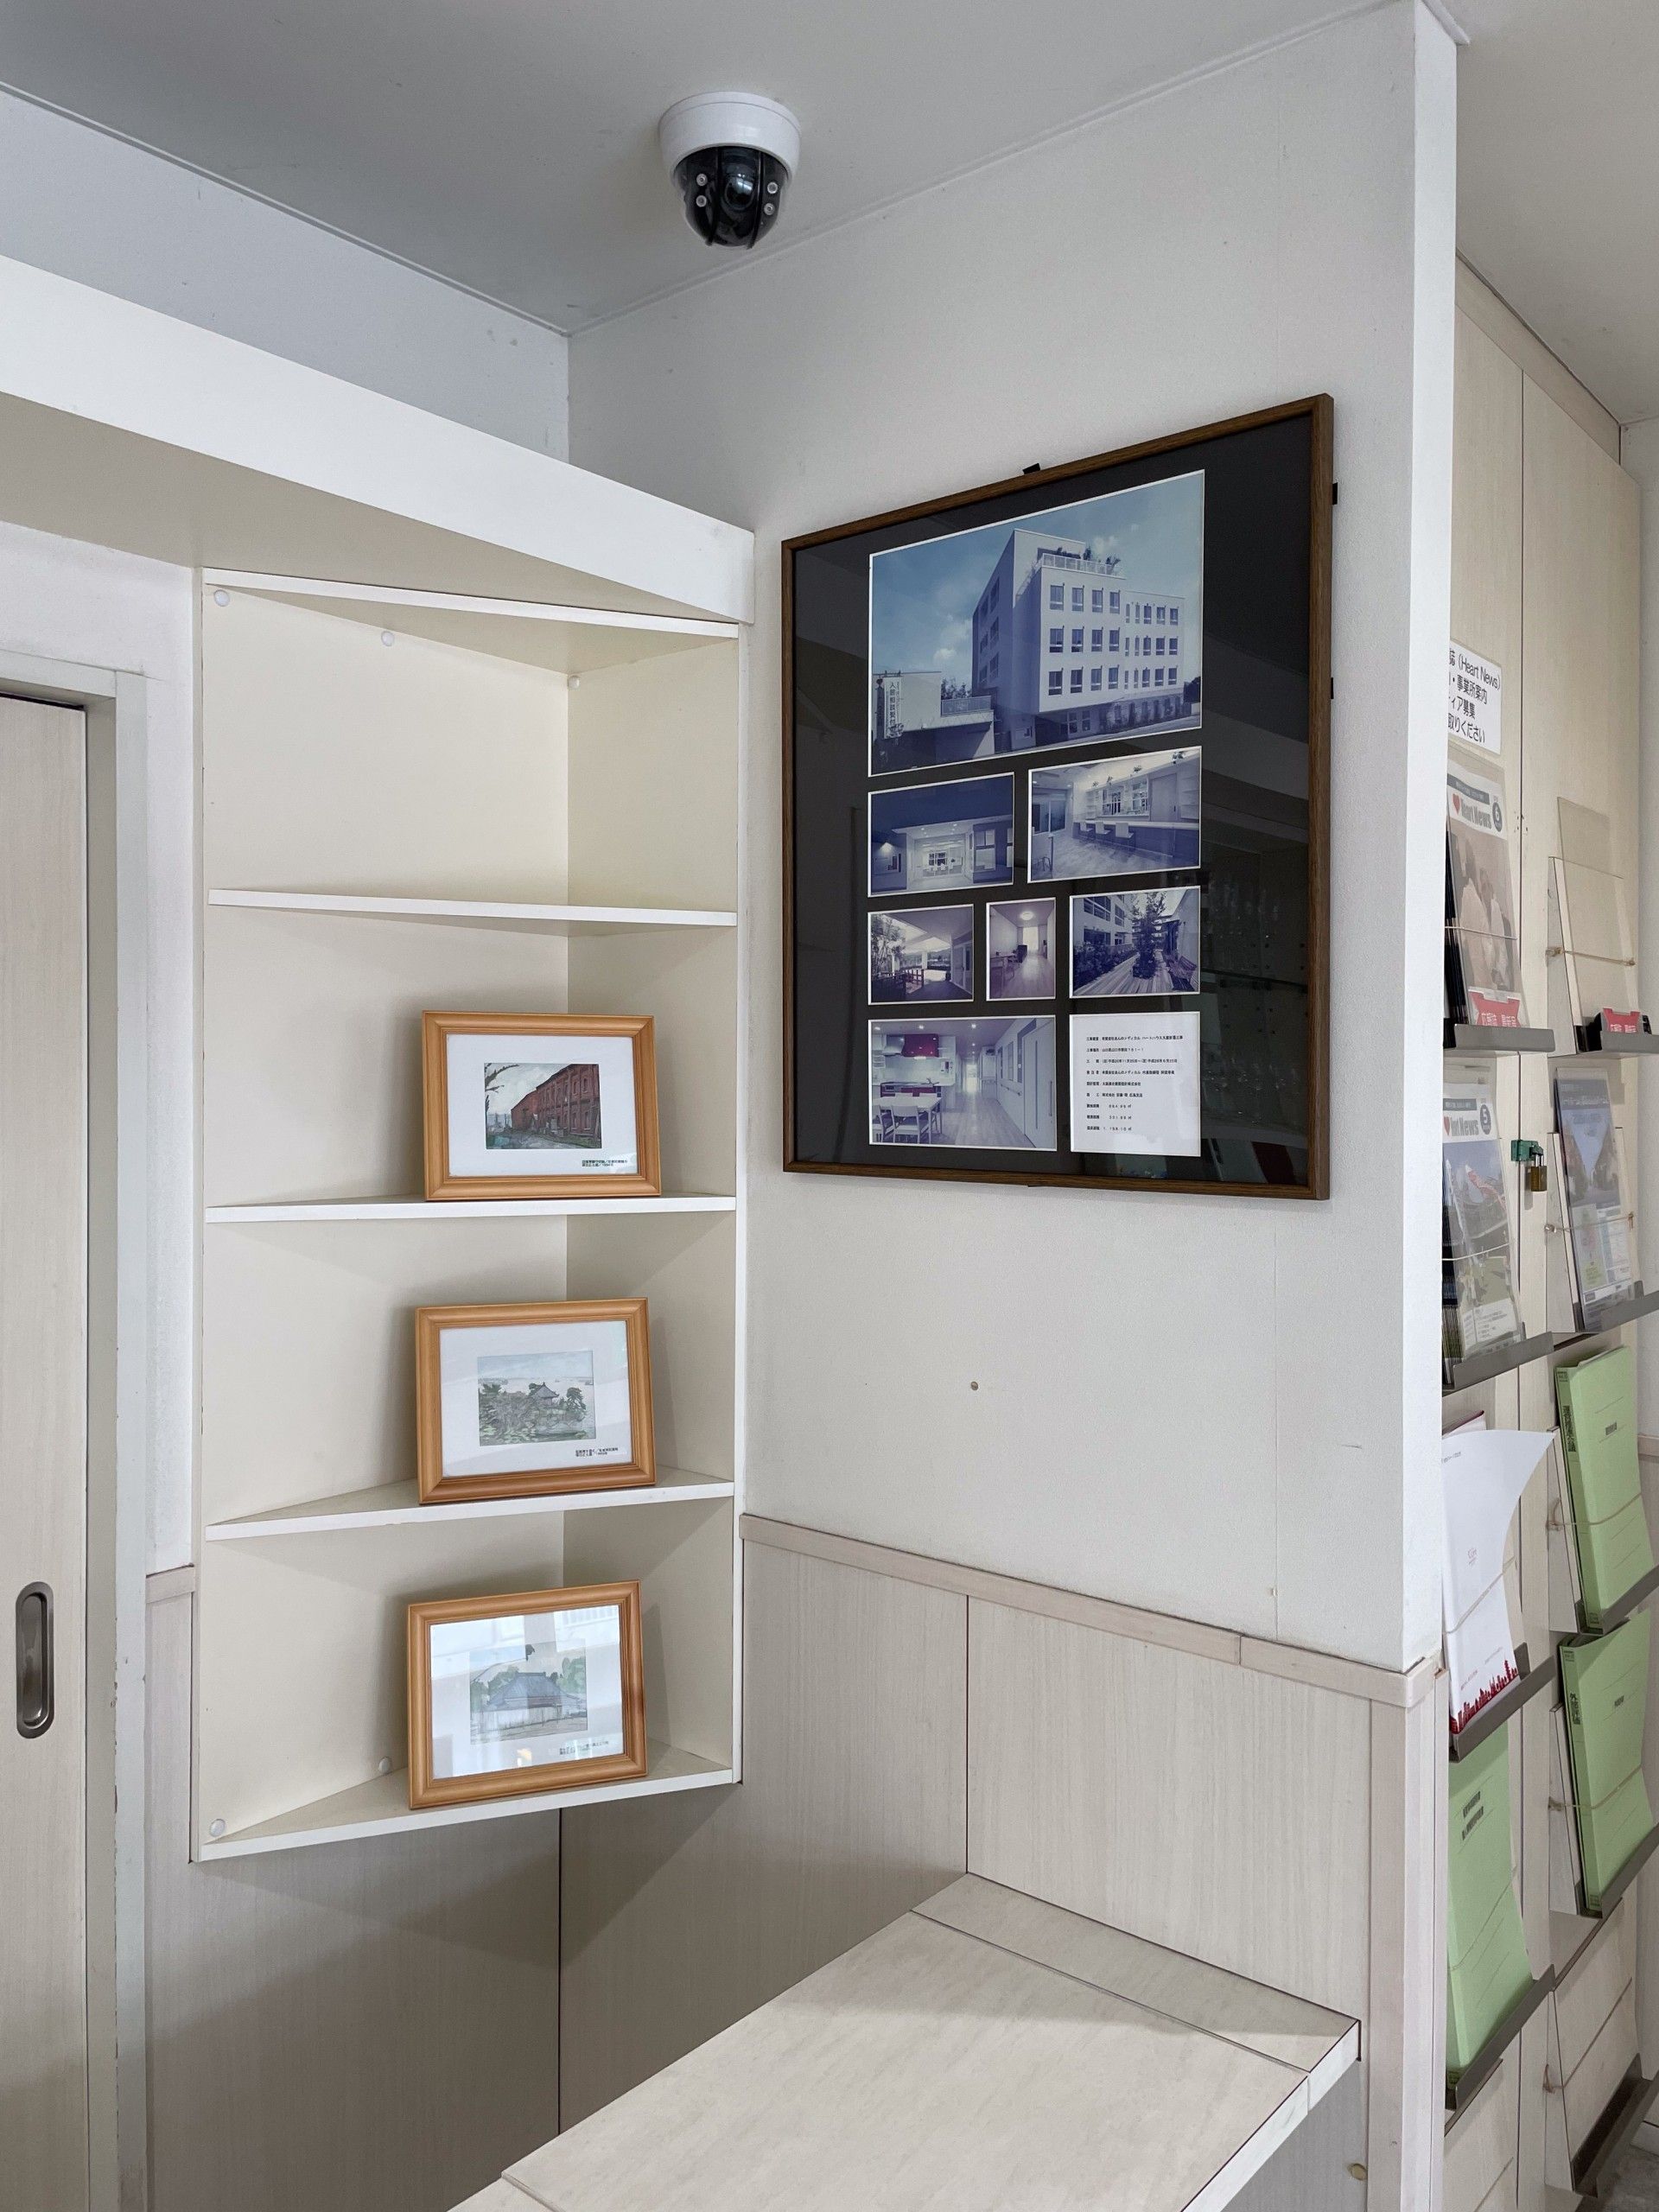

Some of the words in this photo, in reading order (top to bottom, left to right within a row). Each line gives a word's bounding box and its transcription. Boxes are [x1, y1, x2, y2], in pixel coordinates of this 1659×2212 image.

[1449, 671, 1488, 705] ・事業所案内
[1449, 695, 1476, 719] ィア募集
